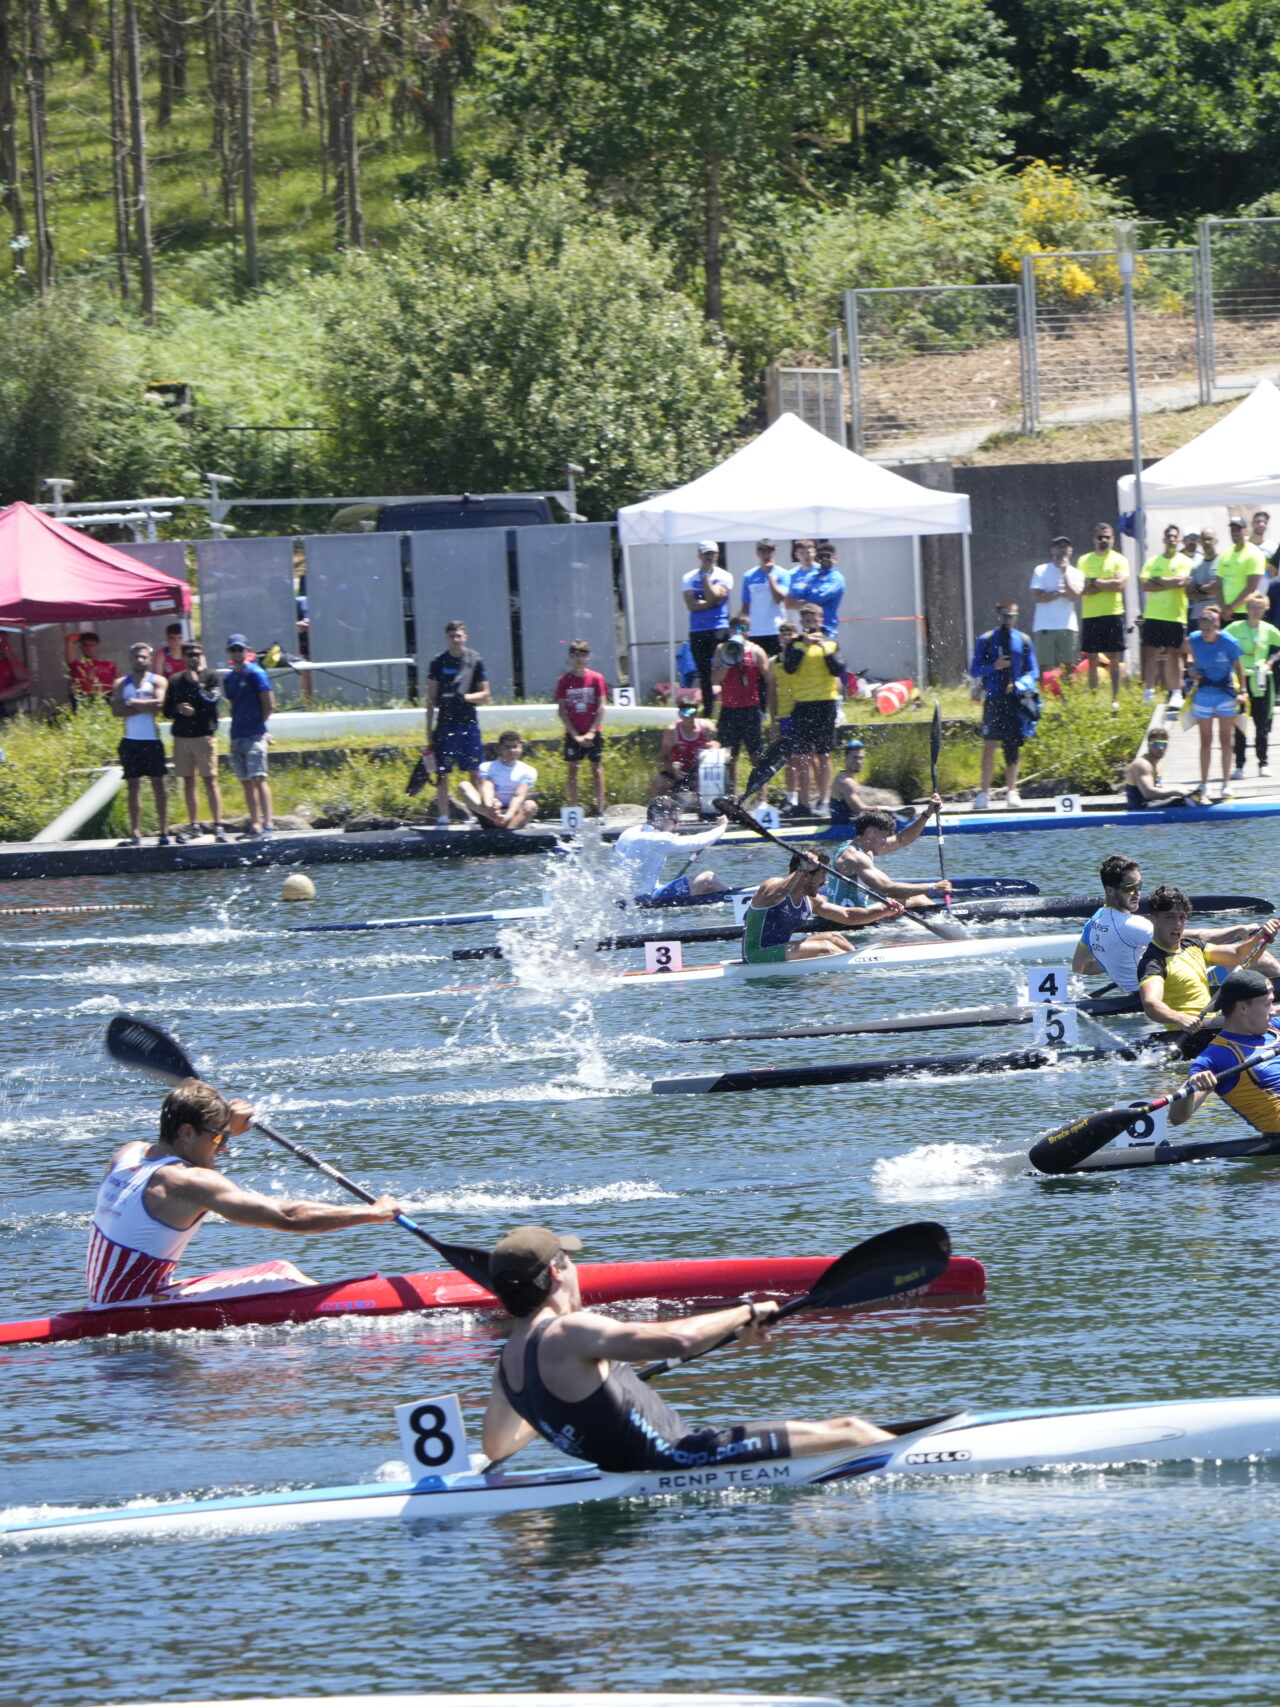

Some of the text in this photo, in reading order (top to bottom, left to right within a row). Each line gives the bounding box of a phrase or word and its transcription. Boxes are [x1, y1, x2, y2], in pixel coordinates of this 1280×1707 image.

[620, 689, 631, 707] 5
[1062, 798, 1073, 812] 9
[567, 811, 578, 828] 6
[762, 812, 772, 824] 4
[655, 946, 671, 965] 3
[1038, 973, 1058, 996] 4
[1046, 1009, 1065, 1040] 5
[321, 1301, 376, 1311] NELO
[409, 1405, 454, 1467] 8
[906, 1450, 971, 1465] NELO
[659, 1466, 789, 1488] RCNP TEAM
